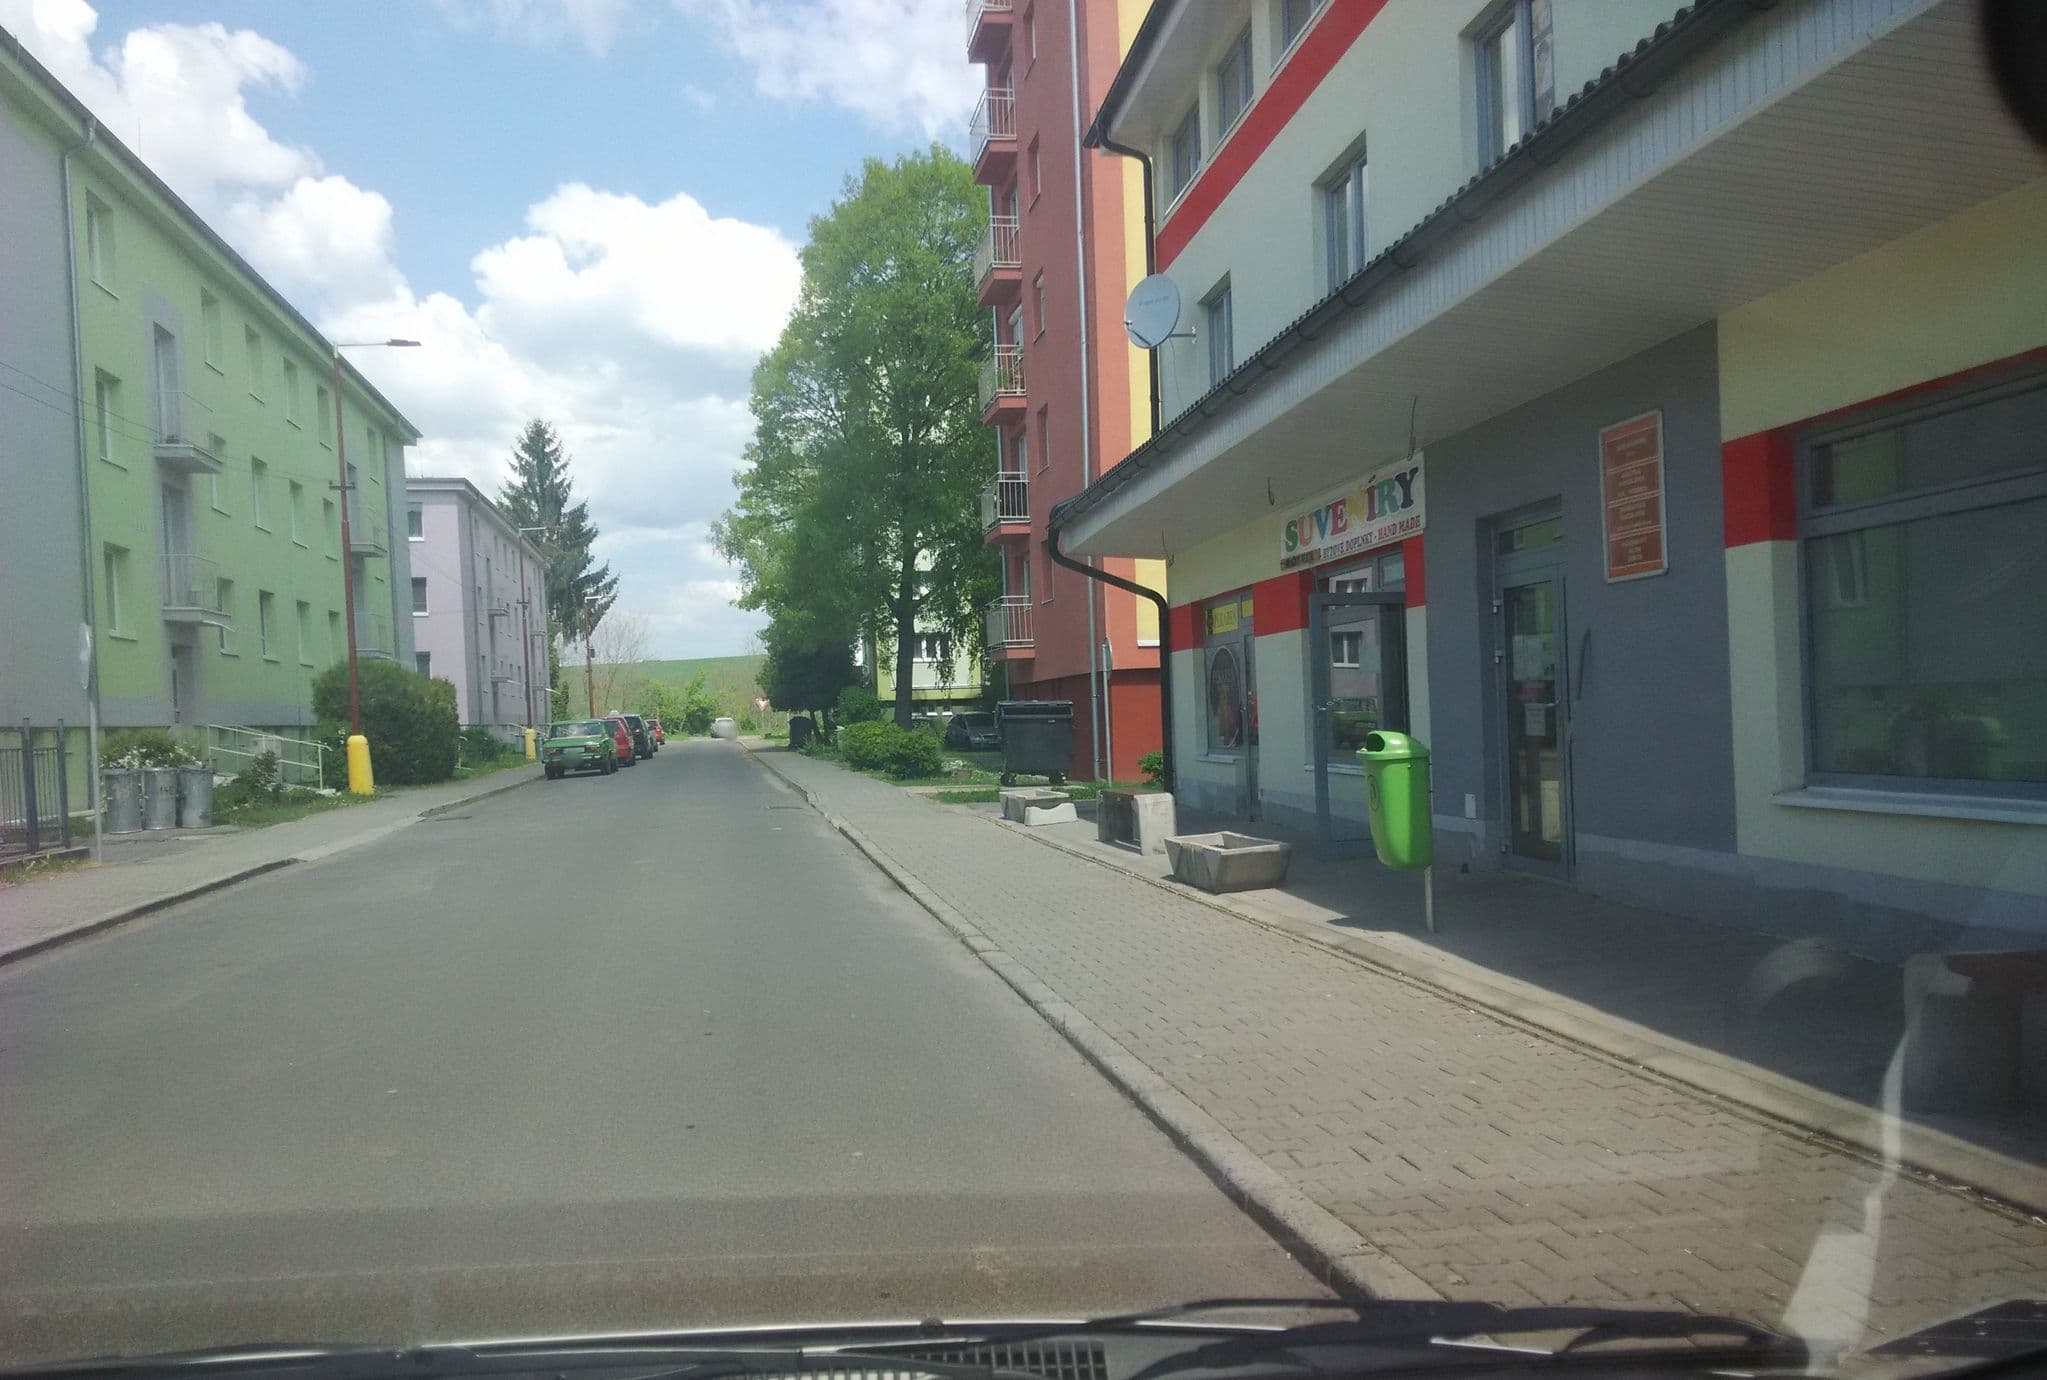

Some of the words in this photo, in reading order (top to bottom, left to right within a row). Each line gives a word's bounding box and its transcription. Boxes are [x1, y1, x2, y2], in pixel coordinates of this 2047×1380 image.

[1285, 466, 1419, 553] SUVENÍRY
[1378, 521, 1397, 541] HAND
[1398, 515, 1421, 534] MADE
